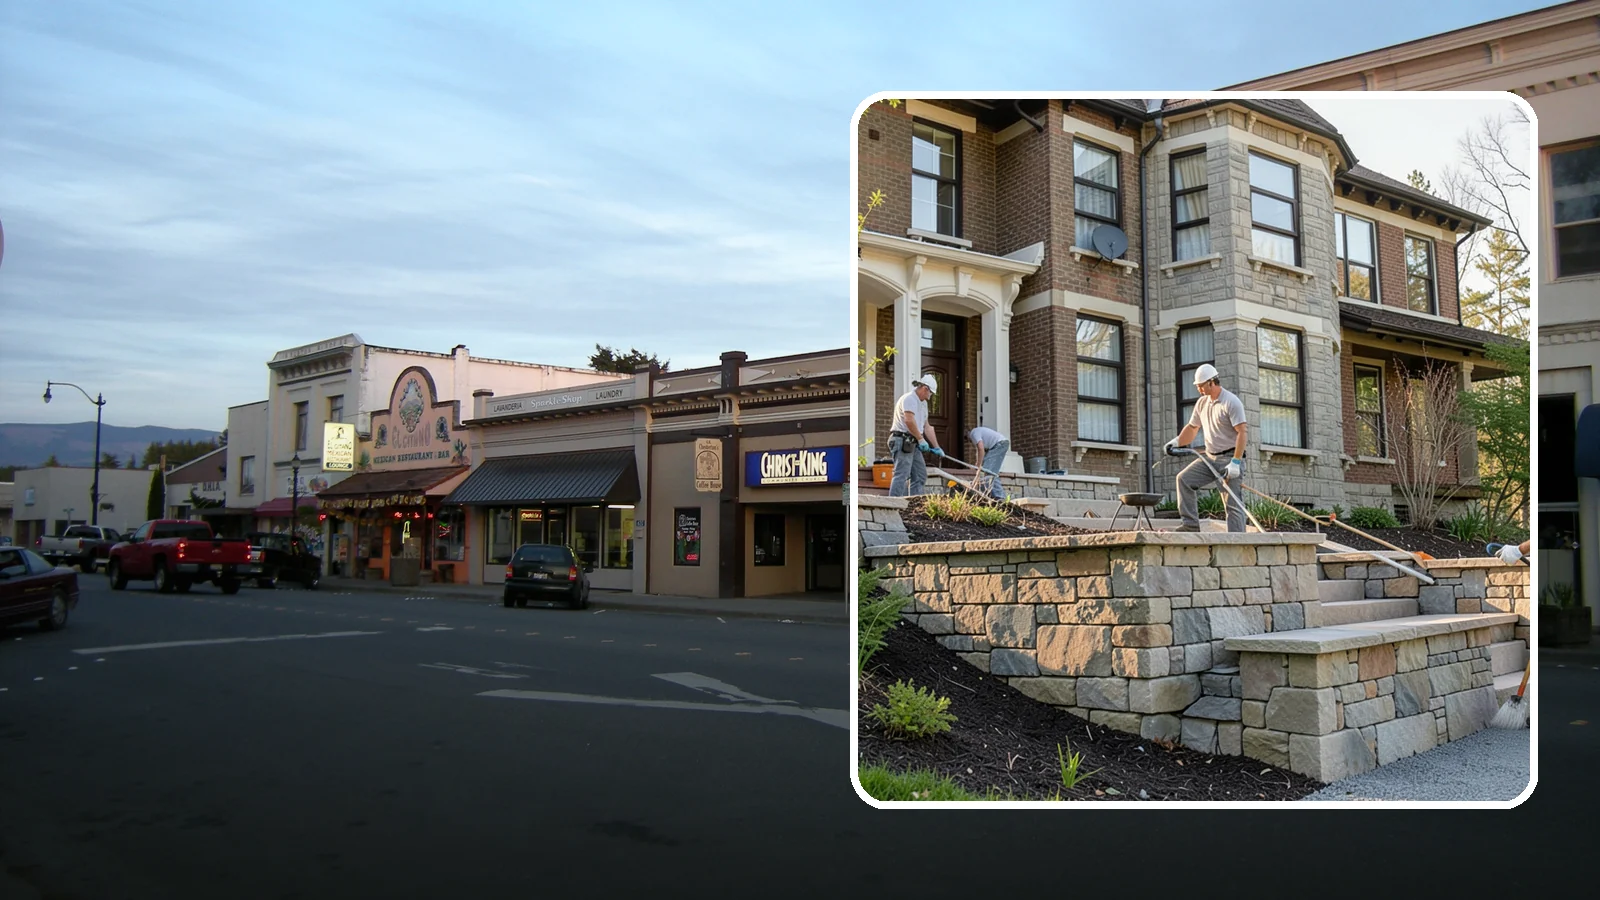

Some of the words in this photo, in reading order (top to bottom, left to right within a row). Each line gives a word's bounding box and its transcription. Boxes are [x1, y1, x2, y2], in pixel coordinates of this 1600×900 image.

[595, 389, 624, 400] LAUNDRY
[493, 402, 523, 412] LAVANDERIA
[531, 396, 561, 408] Sparkle
[562, 394, 583, 404] Shop
[397, 451, 434, 462] RESTAURANT
[438, 450, 450, 459] BAR
[761, 452, 798, 478] CHRIST
[799, 450, 827, 476] KING
